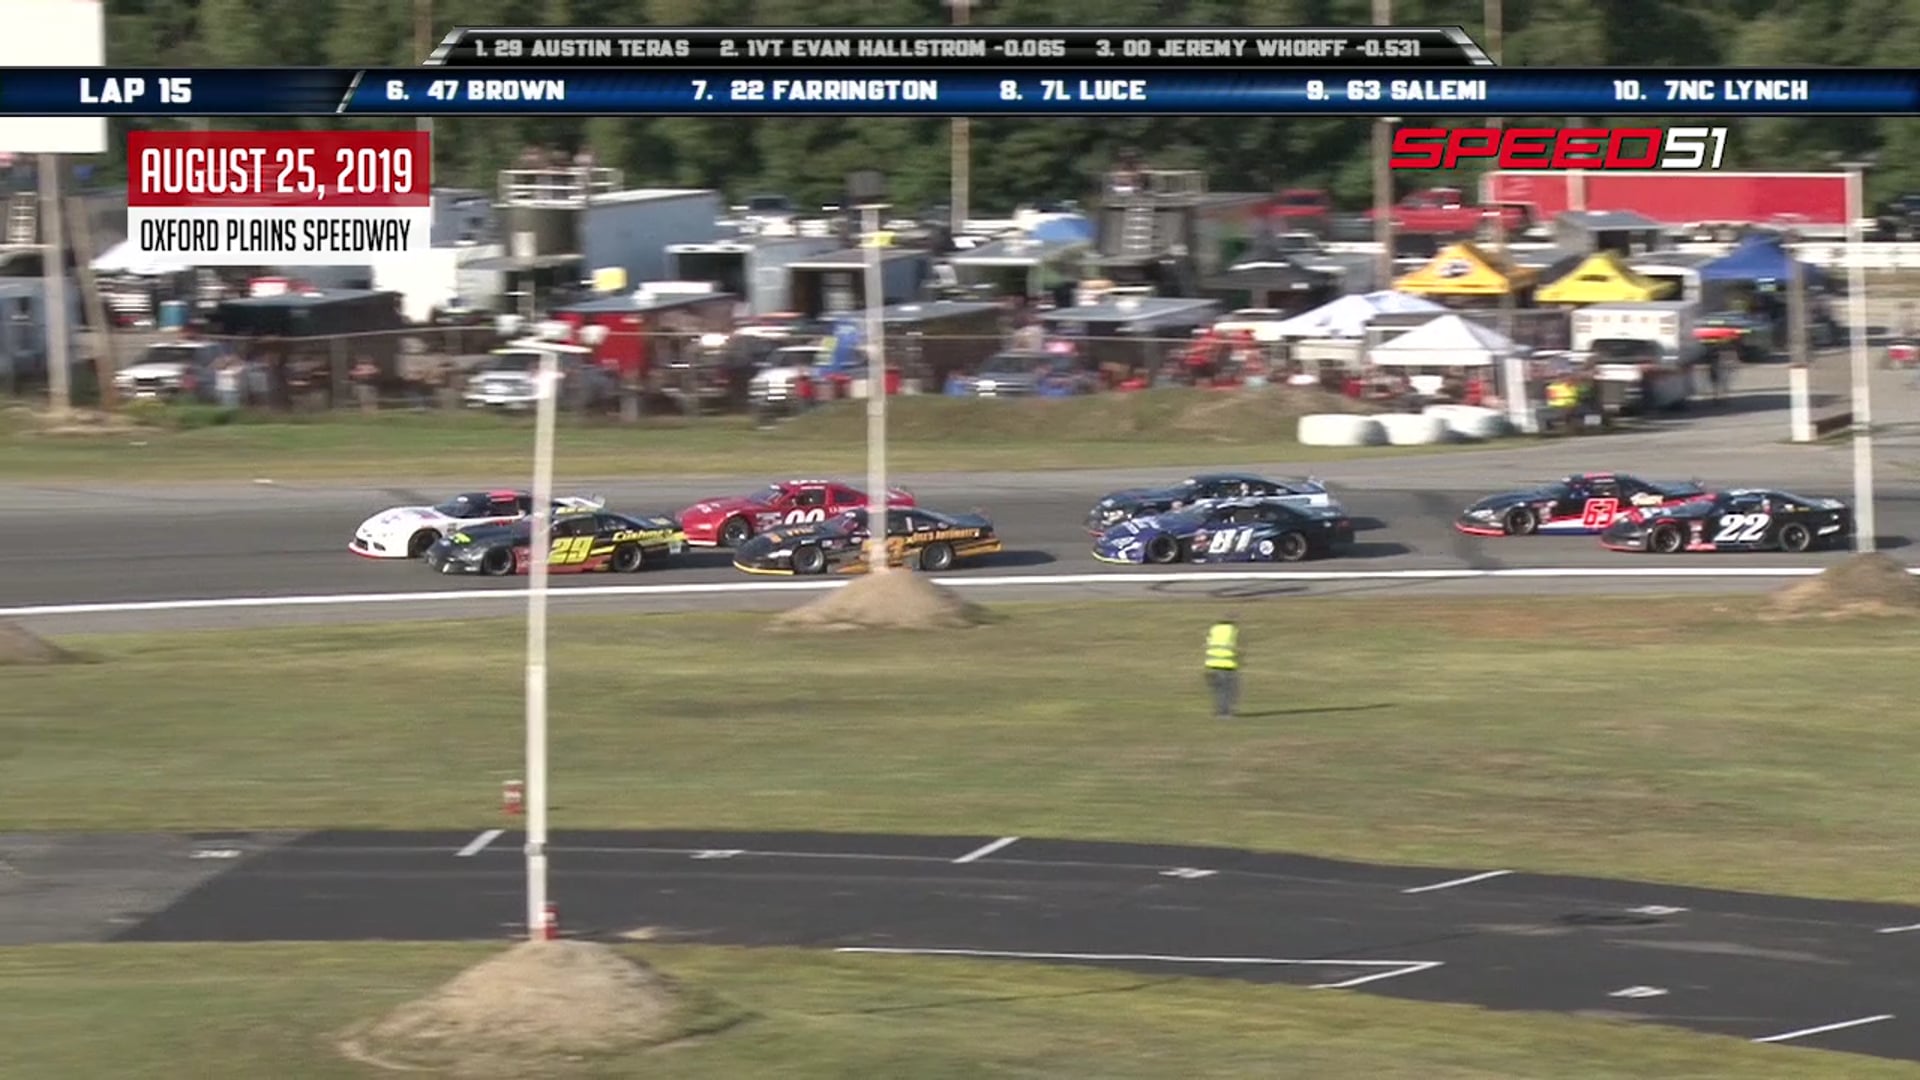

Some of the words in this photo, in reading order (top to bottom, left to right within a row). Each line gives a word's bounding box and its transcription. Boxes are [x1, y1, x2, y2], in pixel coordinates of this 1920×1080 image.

[1583, 498, 1619, 528] 63
[1208, 528, 1254, 553] 81
[1714, 513, 1771, 542] 22
[548, 536, 595, 563] 29
